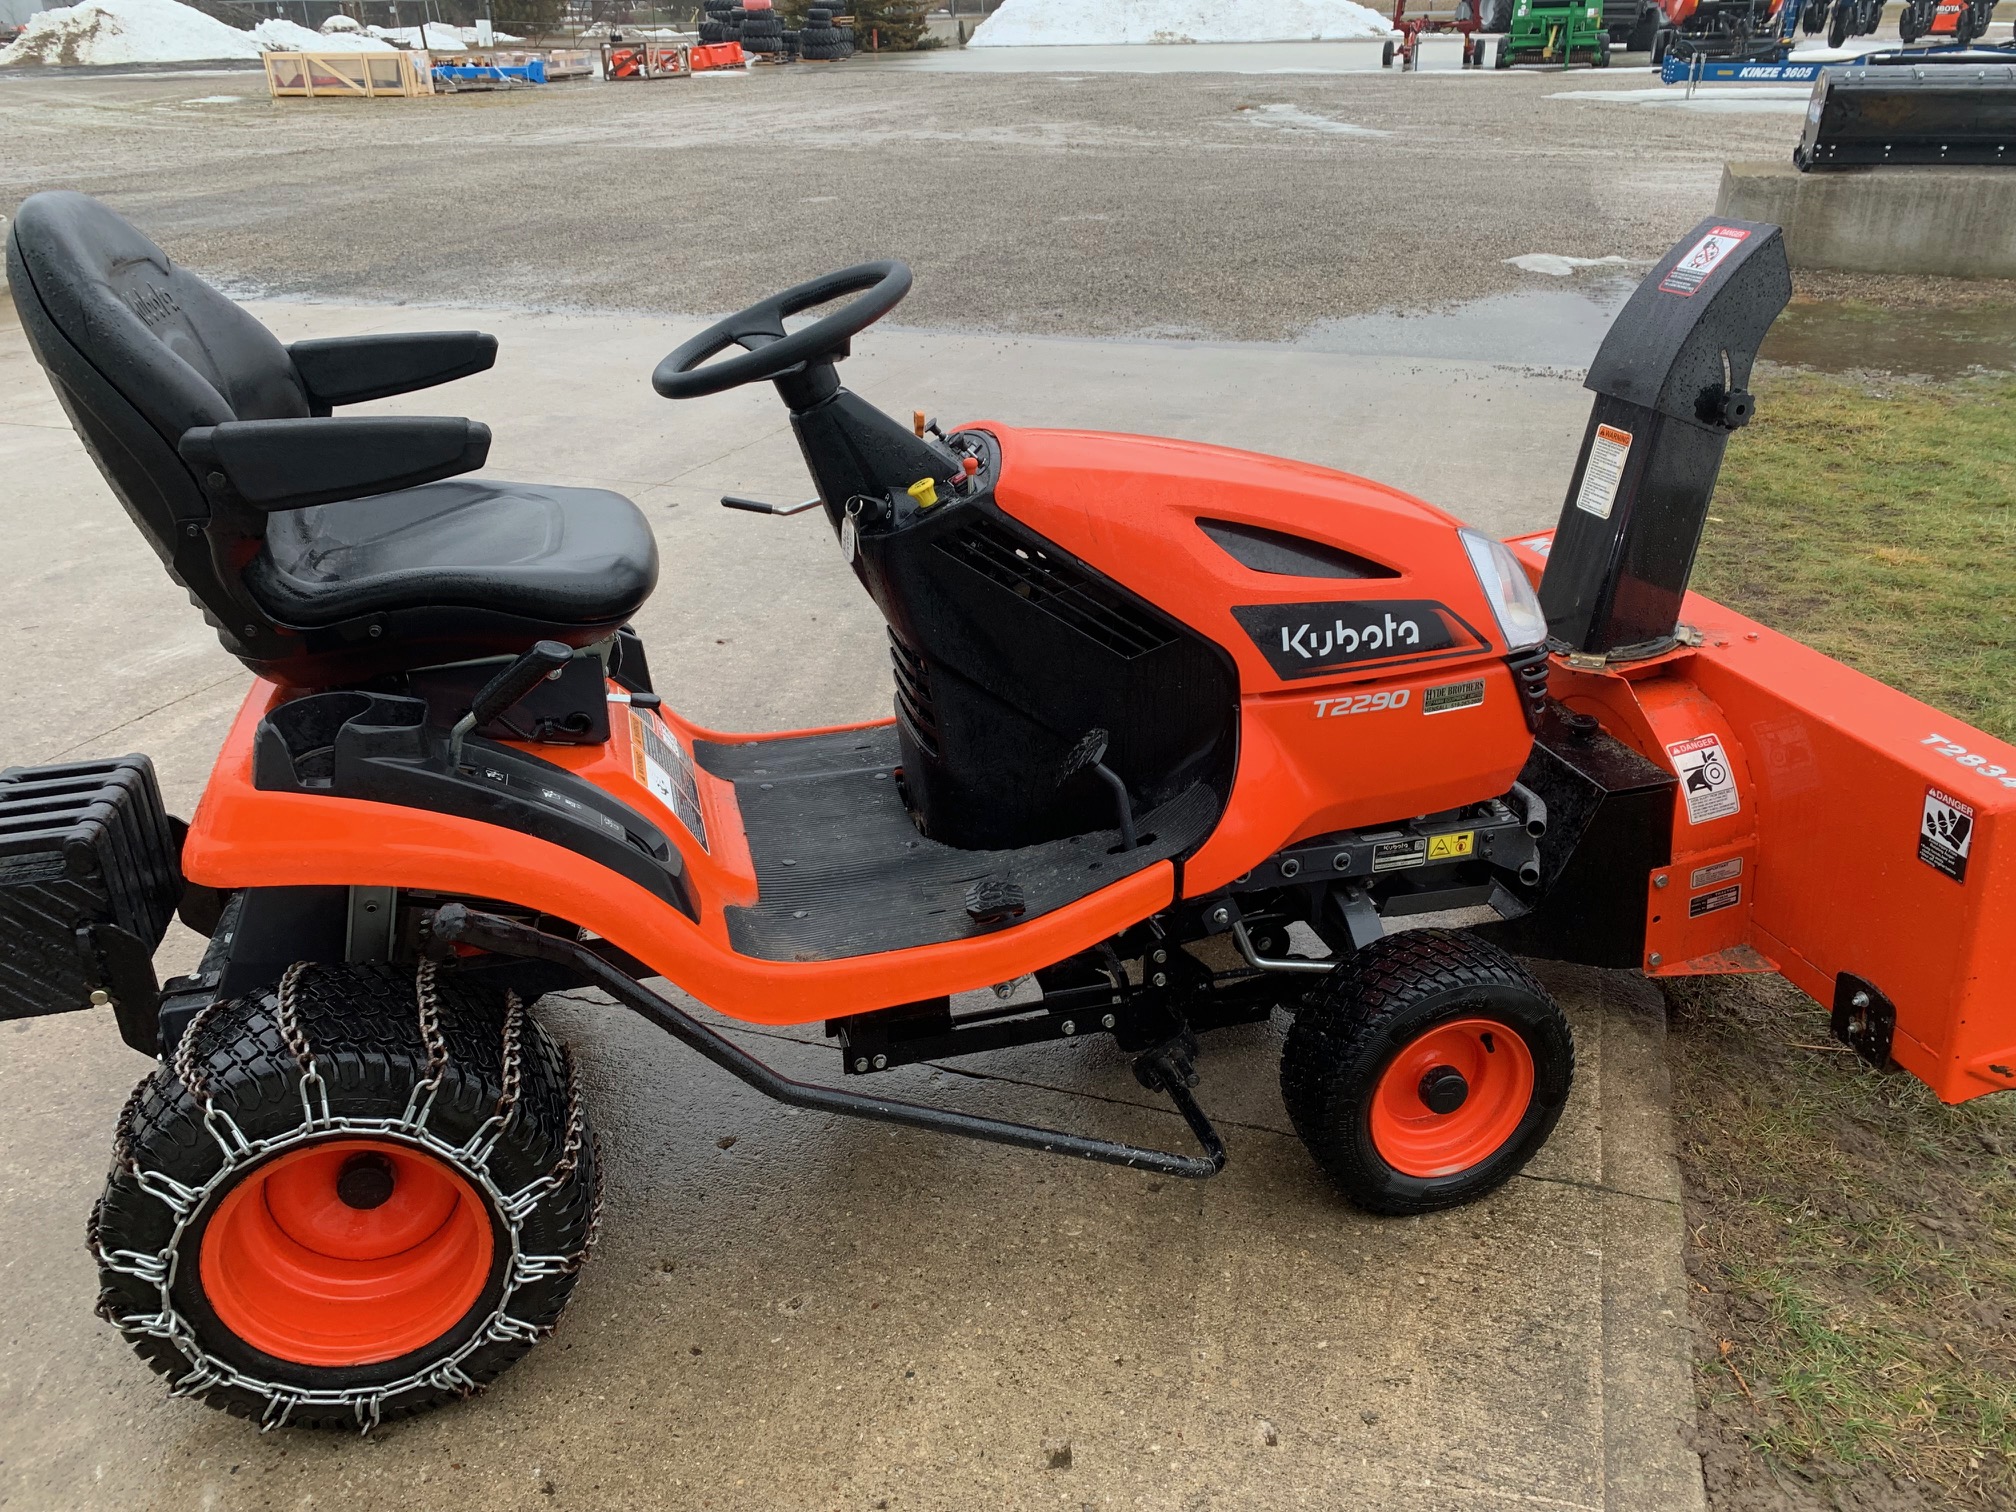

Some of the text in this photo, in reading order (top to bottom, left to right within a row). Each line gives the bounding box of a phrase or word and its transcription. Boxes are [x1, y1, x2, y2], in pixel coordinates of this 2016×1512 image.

[1739, 66, 1814, 78] KINZE 3605
[1719, 229, 1746, 238] DANGER
[1605, 430, 1630, 445] WARNING
[1281, 613, 1420, 659] Kubota
[1425, 681, 1484, 701] HYDE BROTHERS
[1313, 689, 1411, 718] T2290
[1680, 738, 1715, 753] DANGER
[1935, 789, 1974, 818] DANGER
[1383, 842, 1409, 852] Kubota
